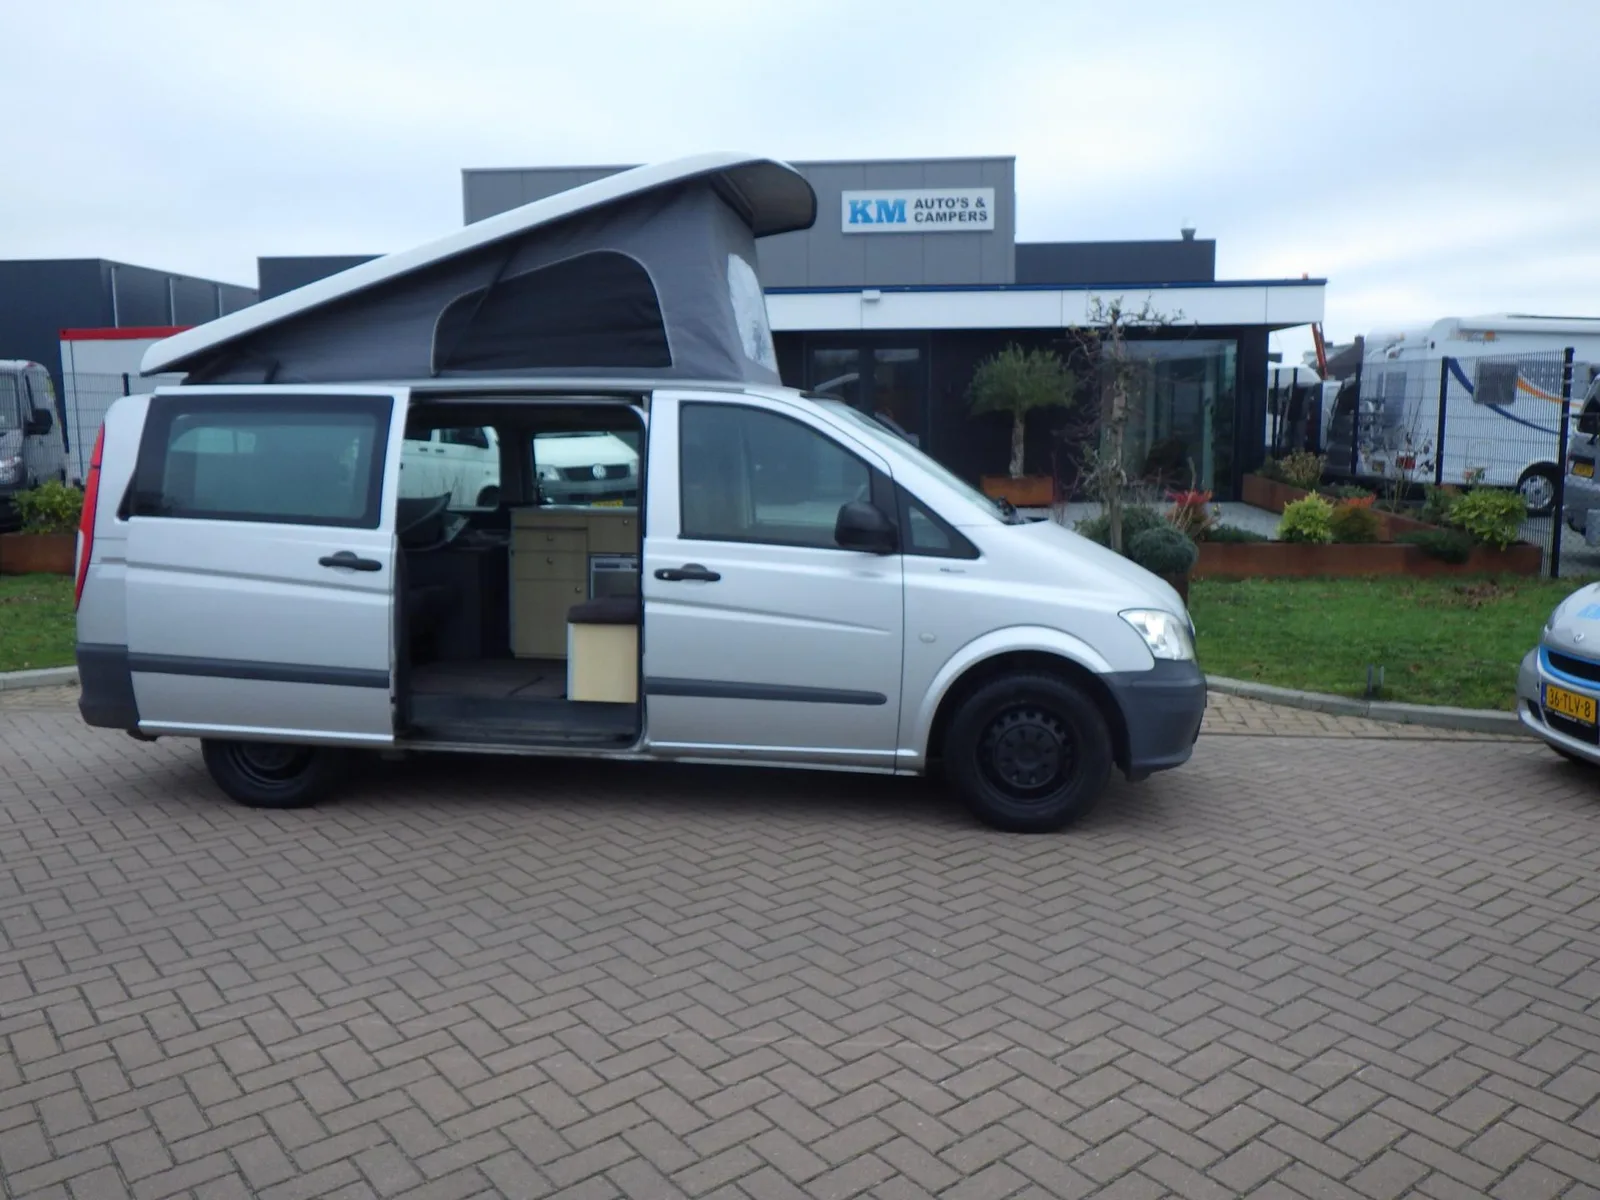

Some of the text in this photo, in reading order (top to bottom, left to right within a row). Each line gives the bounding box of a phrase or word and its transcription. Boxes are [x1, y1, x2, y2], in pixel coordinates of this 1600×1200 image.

[848, 199, 907, 224] KM
[914, 197, 986, 210] AUTO'S &
[914, 210, 988, 223] CAMPERS
[1549, 688, 1591, 718] 36-TLV-8
